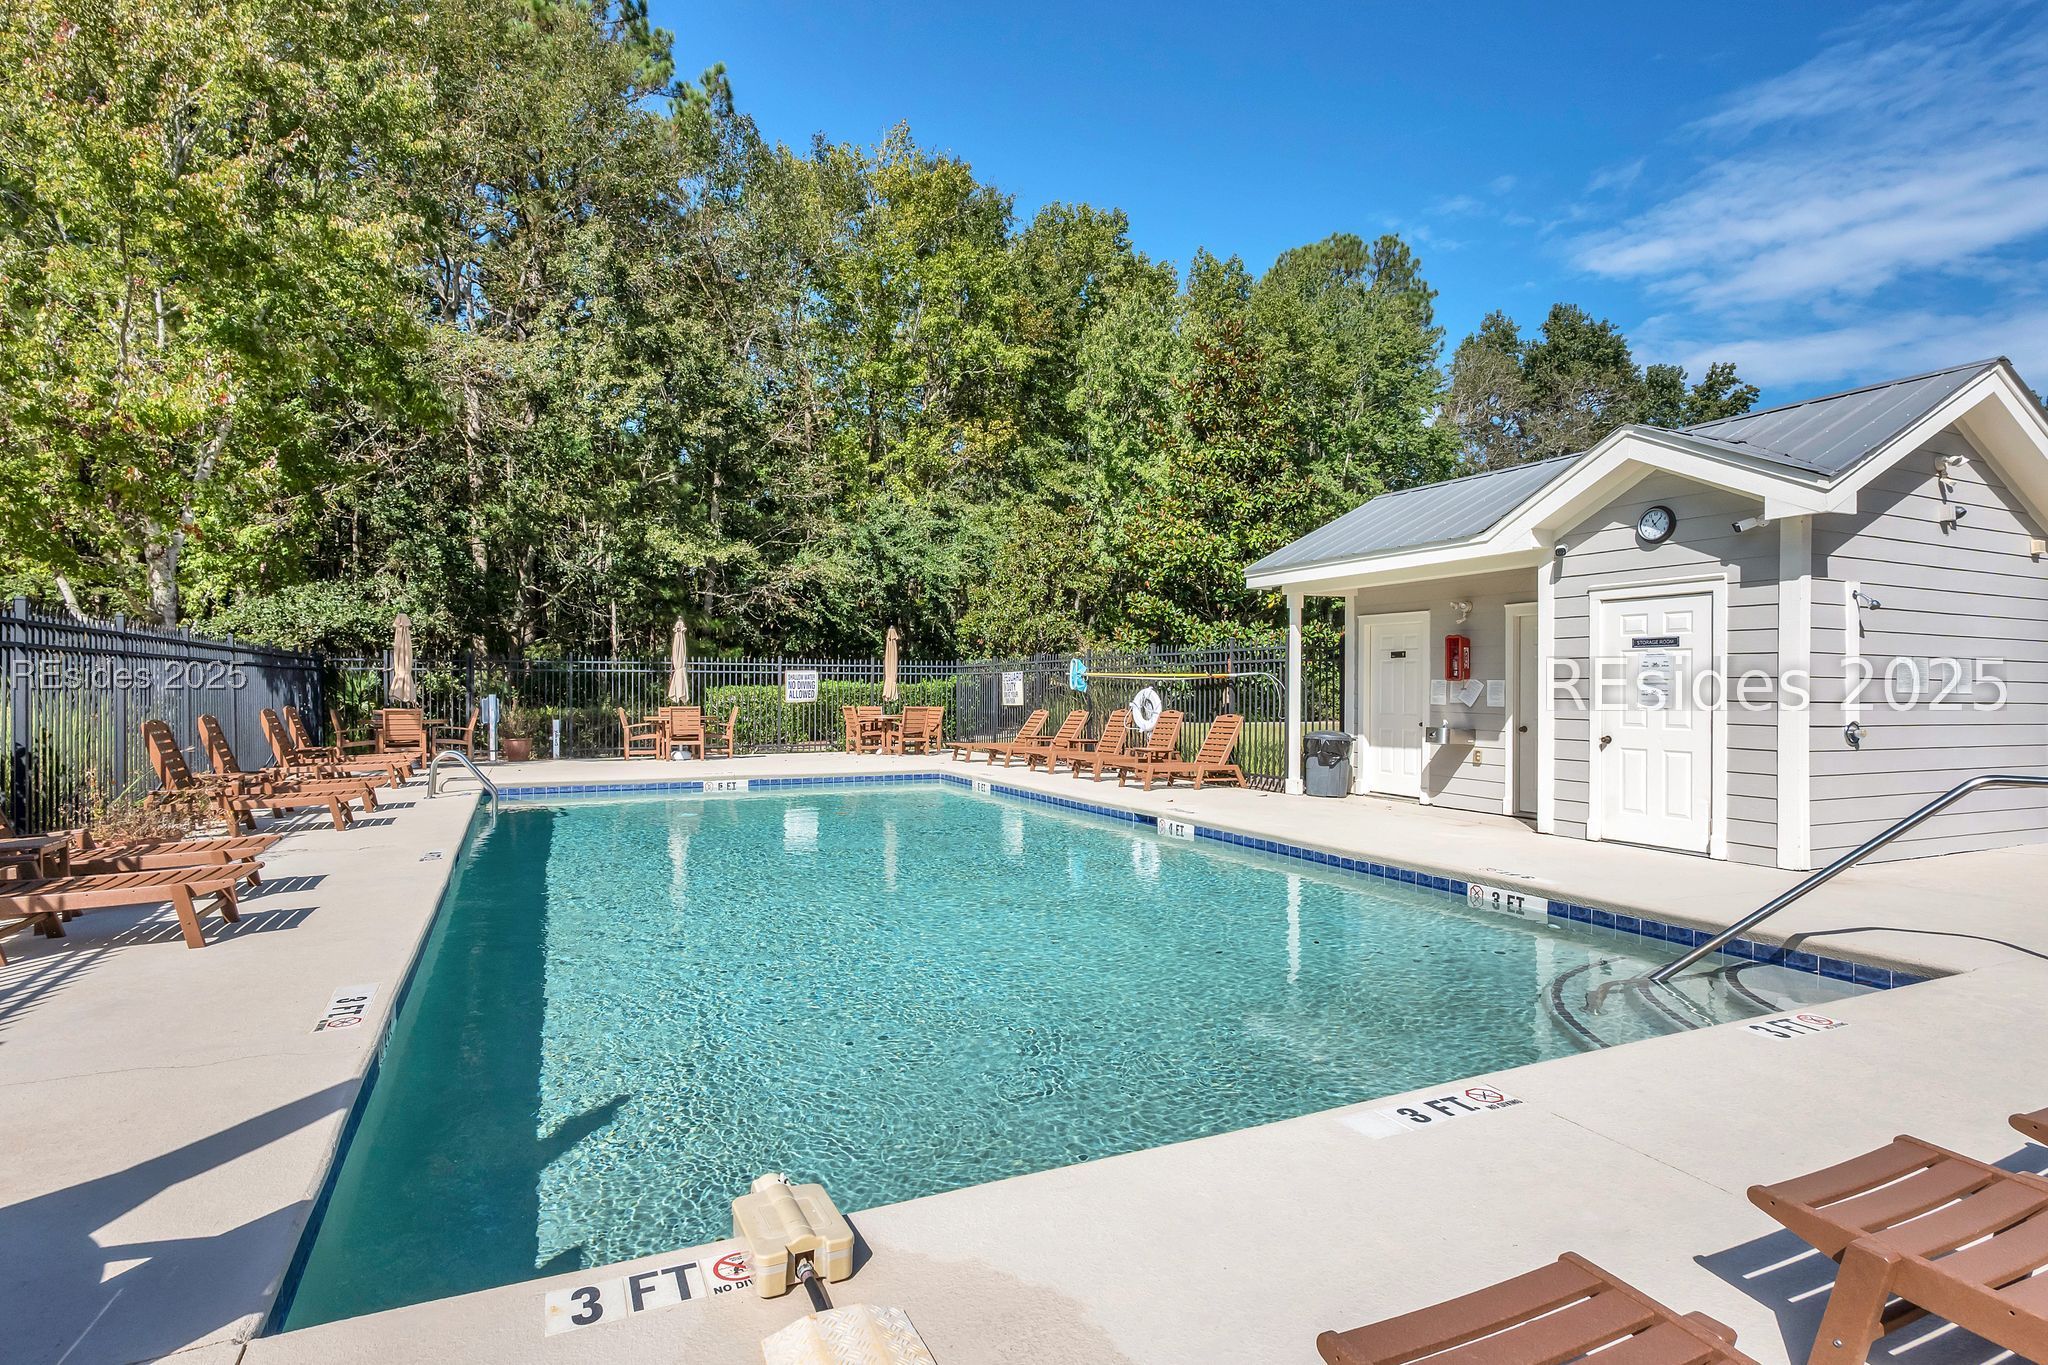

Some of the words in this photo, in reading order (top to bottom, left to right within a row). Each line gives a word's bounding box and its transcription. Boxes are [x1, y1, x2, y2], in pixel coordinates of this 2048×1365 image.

[787, 680, 796, 690] NO
[797, 680, 815, 690] DIVING
[788, 690, 815, 699] ALLOWED
[1491, 891, 1501, 904] 3
[1506, 894, 1525, 908] FT
[1748, 1024, 1792, 1039] 3
[1766, 1018, 1821, 1035] FT
[1396, 1107, 1432, 1123] 3
[1423, 1096, 1481, 1117] FT.
[571, 1286, 604, 1326] 3
[628, 1262, 697, 1313] FT
[713, 1284, 732, 1295] NO
